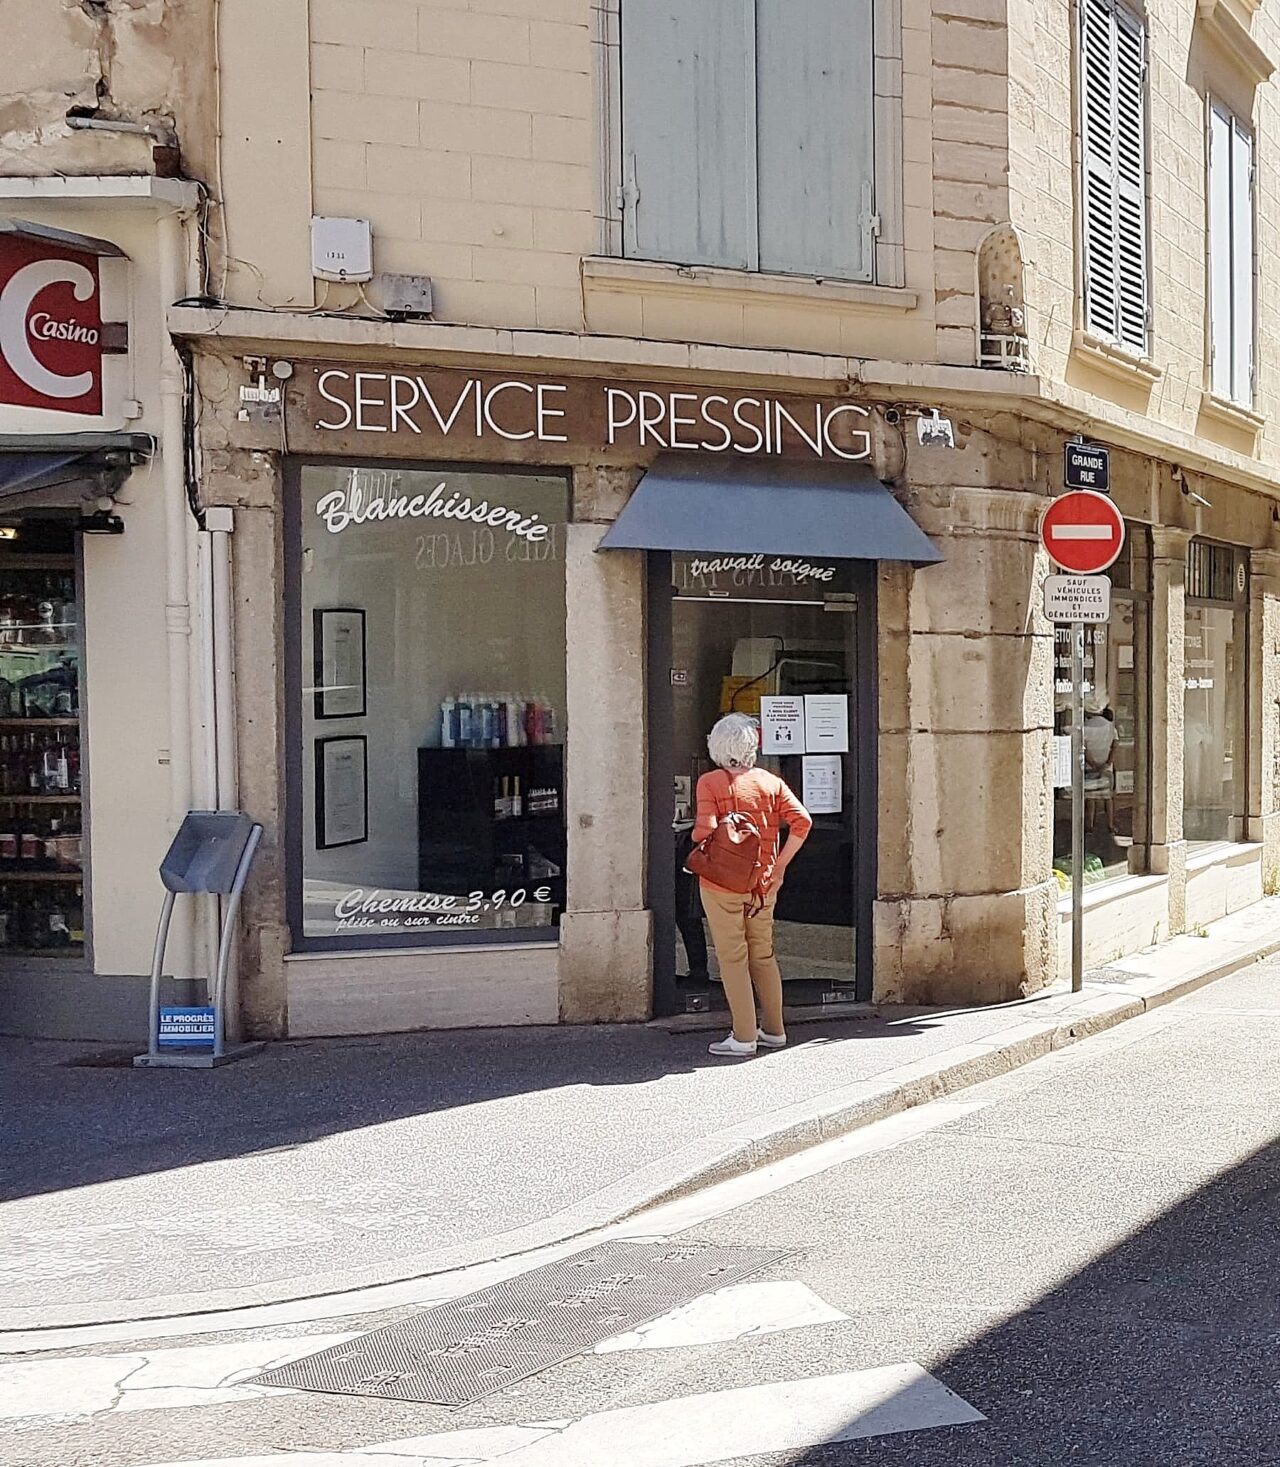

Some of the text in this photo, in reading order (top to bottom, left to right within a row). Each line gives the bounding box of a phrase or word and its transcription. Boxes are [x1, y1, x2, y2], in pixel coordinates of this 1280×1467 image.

[29, 312, 98, 345] Casino
[317, 368, 872, 460] SERVICE PRESSING
[1072, 454, 1103, 470] GRANDE
[1080, 471, 1095, 483] RUE
[316, 470, 549, 541] Blanchisserie
[691, 554, 765, 576] travail
[770, 557, 836, 582] soigné
[1051, 595, 1103, 603] IMMONDICES
[1048, 611, 1105, 619] DÉNEIGEMENT
[335, 888, 457, 918] Chemise
[335, 913, 481, 932] pliée ou sur cintre
[173, 1013, 214, 1022] PROGRÈS
[160, 1025, 214, 1033] IMMOBILIER
